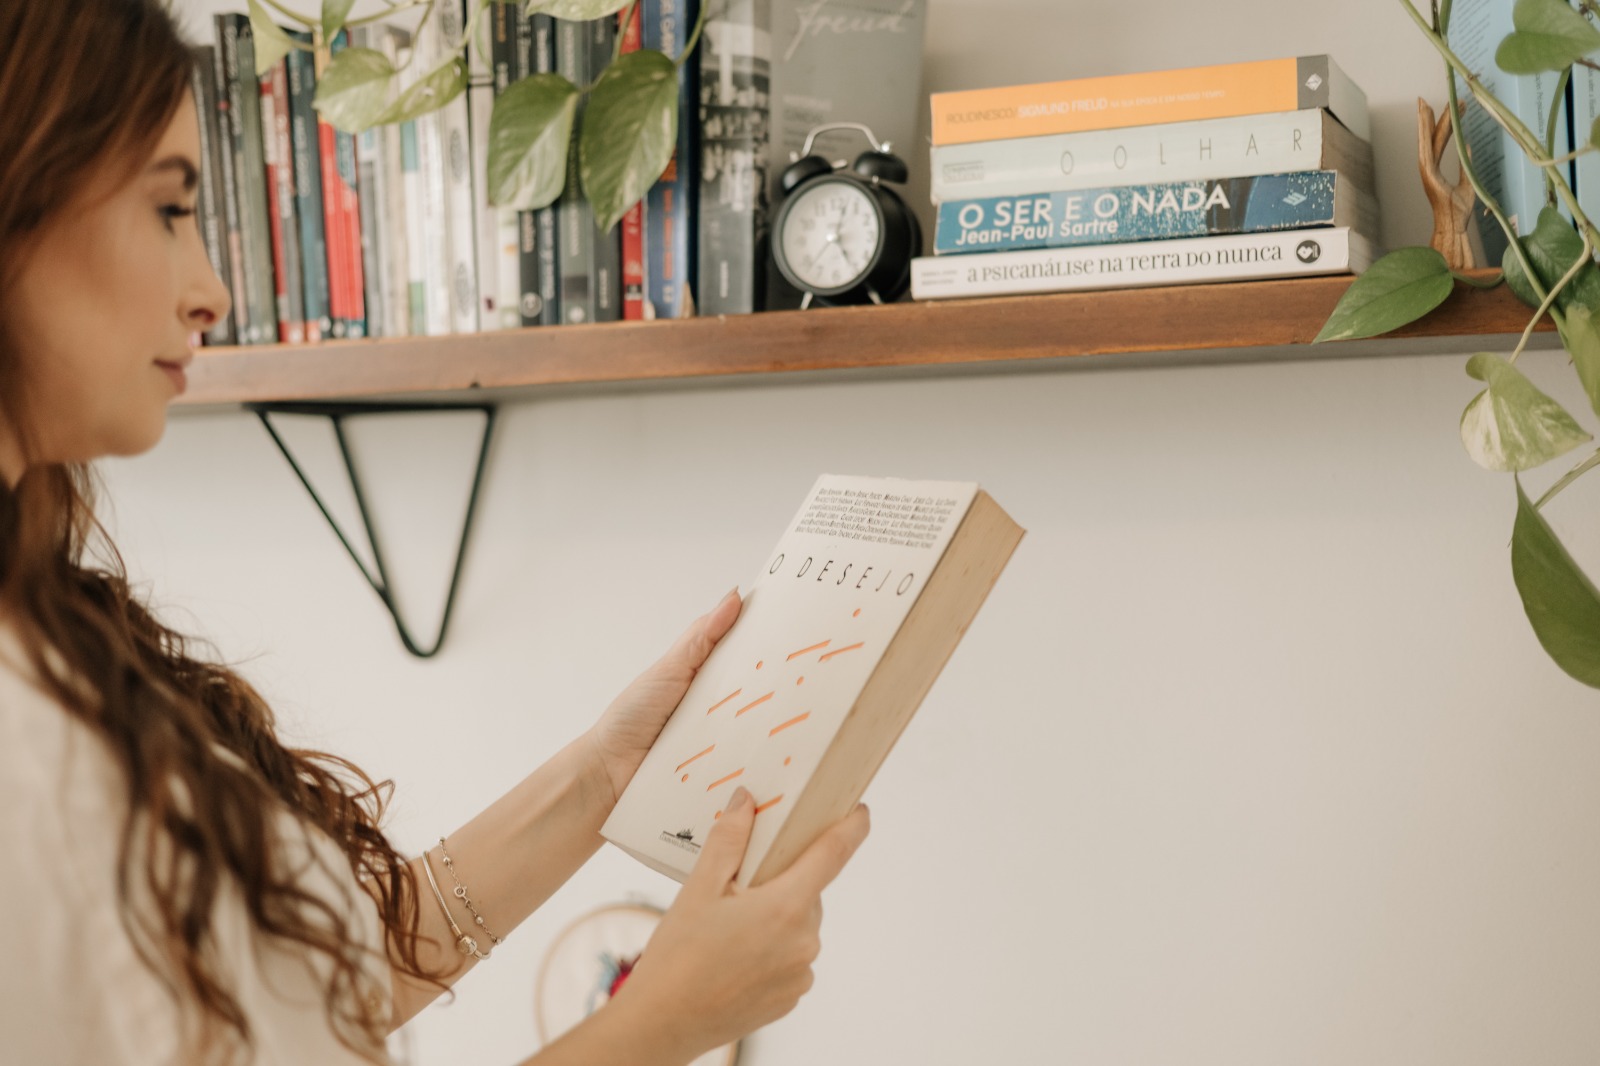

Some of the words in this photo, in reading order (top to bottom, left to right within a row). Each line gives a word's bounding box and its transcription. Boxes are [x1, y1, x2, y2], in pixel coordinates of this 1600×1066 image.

[1018, 102, 1069, 119] SIGMUND
[1072, 97, 1107, 111] FREUD
[1061, 151, 1074, 175] O
[1113, 128, 1302, 170] OLHAR
[958, 204, 984, 229] O
[993, 198, 1053, 227] SER
[1065, 196, 1083, 220] E
[1094, 193, 1120, 217] O
[1132, 184, 1230, 216] NADA
[955, 223, 1054, 246] Jean-Paul
[1060, 218, 1119, 237] Sartre
[1099, 257, 1123, 274] na
[1216, 245, 1282, 265] nunca
[769, 553, 785, 575] O
[796, 556, 914, 596] DESEJO
